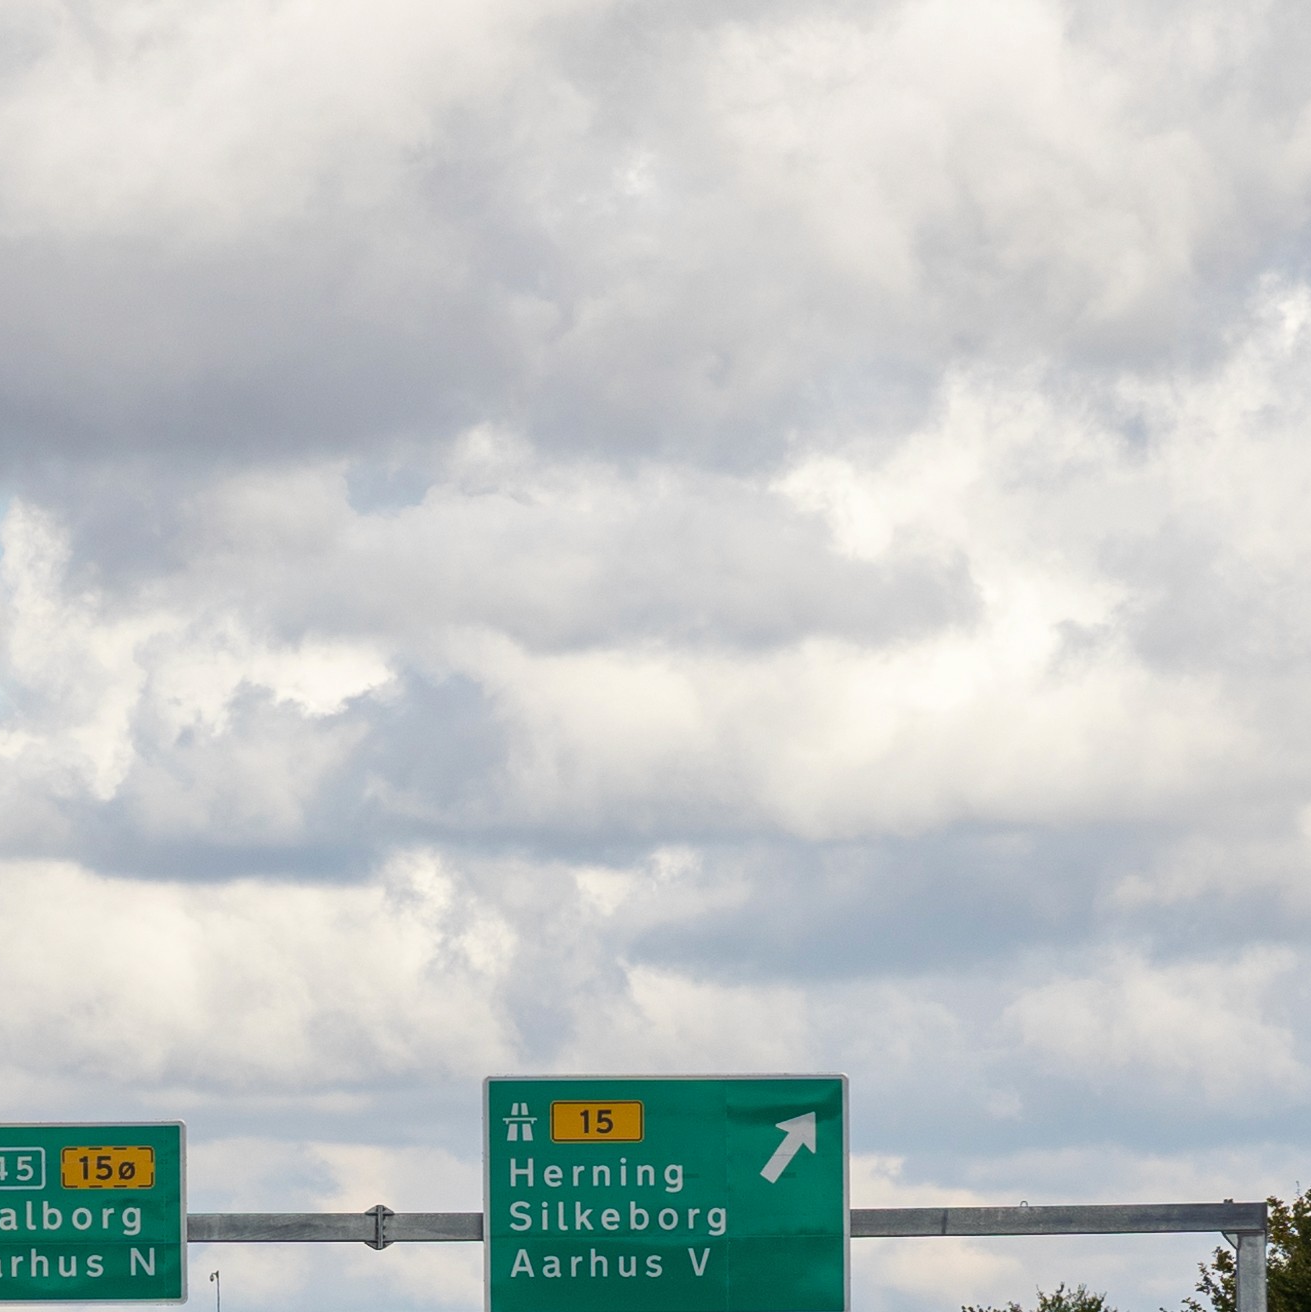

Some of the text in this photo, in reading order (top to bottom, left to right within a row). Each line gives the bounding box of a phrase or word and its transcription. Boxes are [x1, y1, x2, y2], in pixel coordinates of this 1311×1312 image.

[580, 1109, 614, 1134] 15
[79, 1156, 136, 1181] 15ø
[510, 1158, 684, 1193] Herning
[509, 1201, 727, 1236] Silkeborg
[130, 1248, 155, 1276] N
[510, 1248, 711, 1278] Aarhus V
